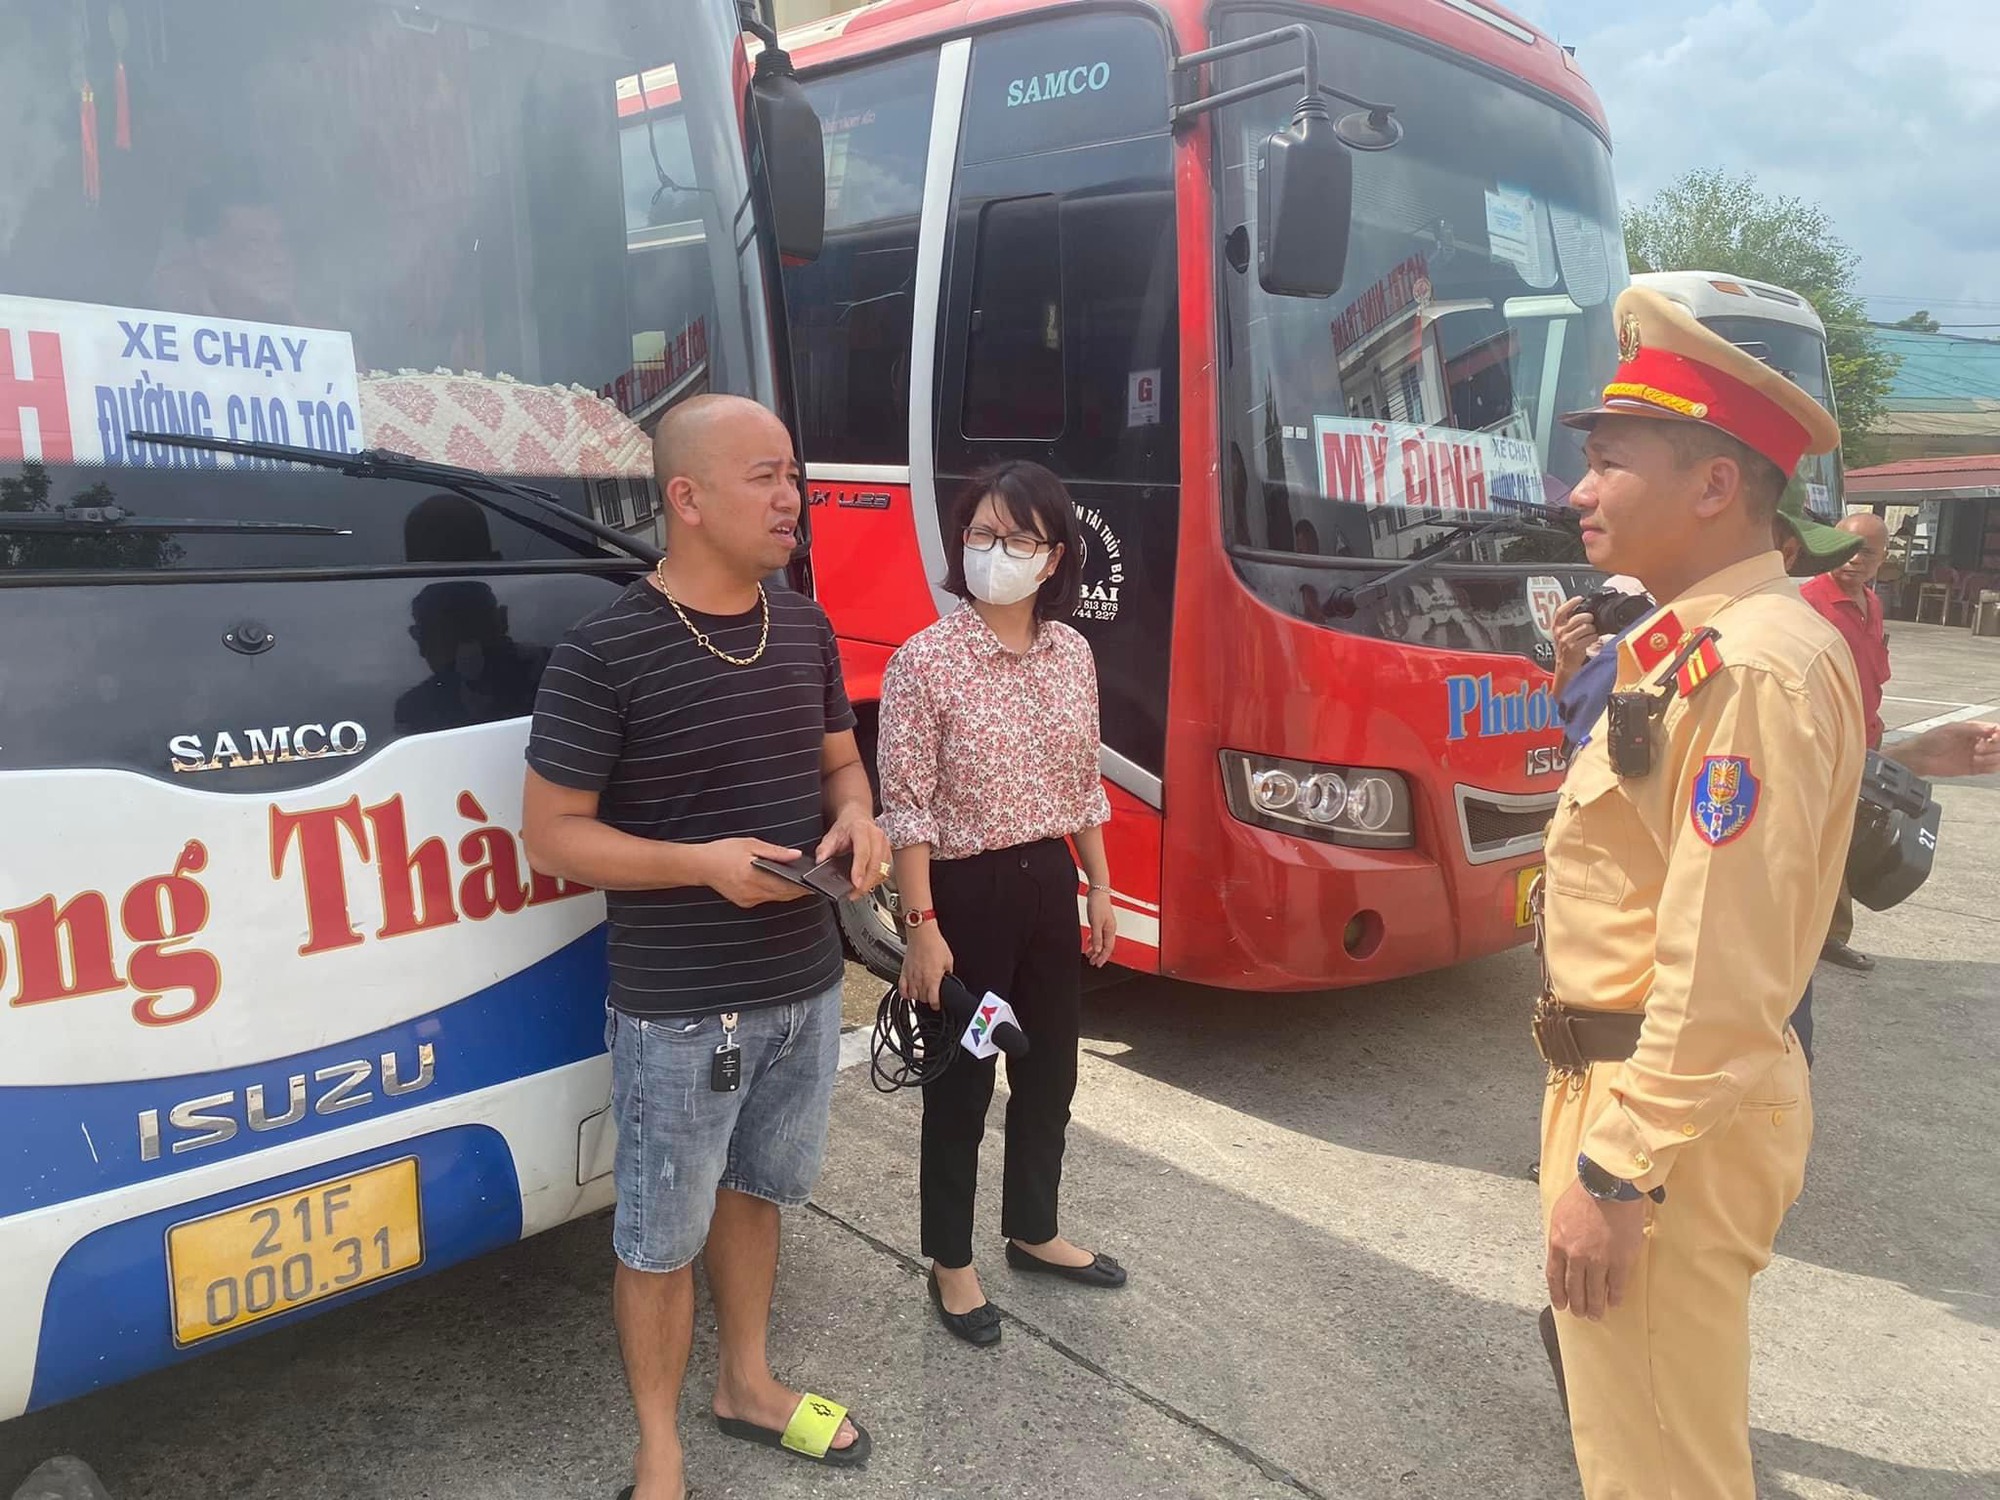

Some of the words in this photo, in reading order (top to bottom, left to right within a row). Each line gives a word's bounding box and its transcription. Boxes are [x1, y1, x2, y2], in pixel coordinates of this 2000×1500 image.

[1007, 61, 1110, 107] SAMCO
[117, 321, 178, 363] XE
[194, 327, 308, 378] CHẠY
[95, 370, 217, 468] ĐƯỜNG
[1323, 422, 1389, 504] MỸ
[1402, 428, 1487, 511] ĐÌNH
[1492, 438, 1507, 459] XE
[1086, 509, 1102, 531] TẢI
[1100, 525, 1121, 559] THỦY
[1109, 563, 1124, 583] BỘ
[1084, 601, 1099, 611] 813
[1101, 601, 1118, 613] 878
[1094, 609, 1117, 621] 227
[168, 720, 367, 773] SAMCO
[1918, 827, 1936, 851] 27
[268, 790, 597, 957] Thà
[138, 1043, 436, 1162] ISUZU
[250, 1184, 352, 1260] 21F
[205, 1226, 392, 1328] 000.31
